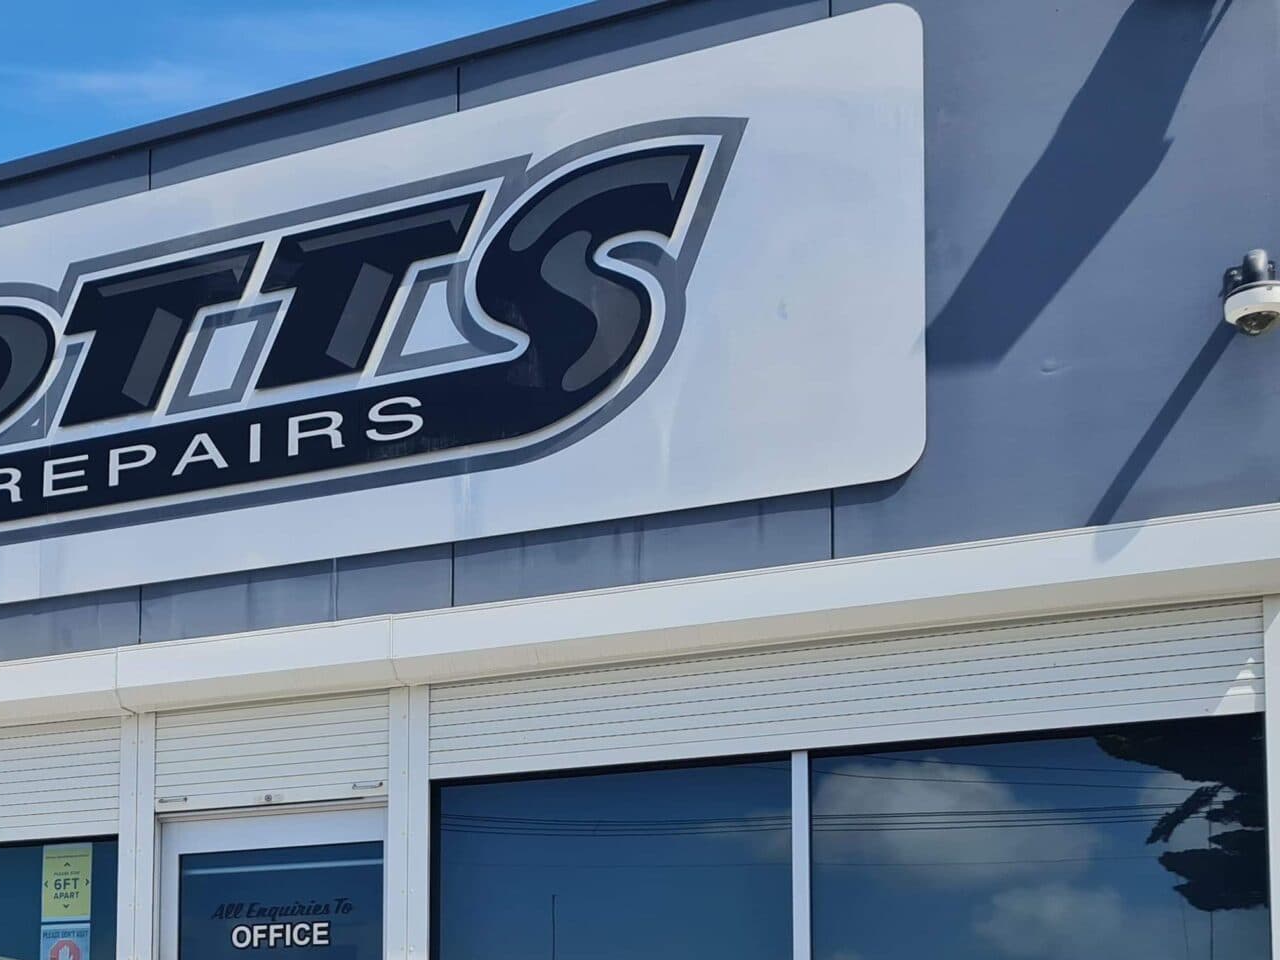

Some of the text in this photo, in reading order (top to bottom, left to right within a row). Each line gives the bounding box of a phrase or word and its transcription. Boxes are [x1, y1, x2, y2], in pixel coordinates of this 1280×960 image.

[54, 878, 80, 890] 6FT
[53, 891, 80, 900] APART
[211, 897, 353, 921] All Enquiries To
[231, 922, 330, 948] OFFICE
